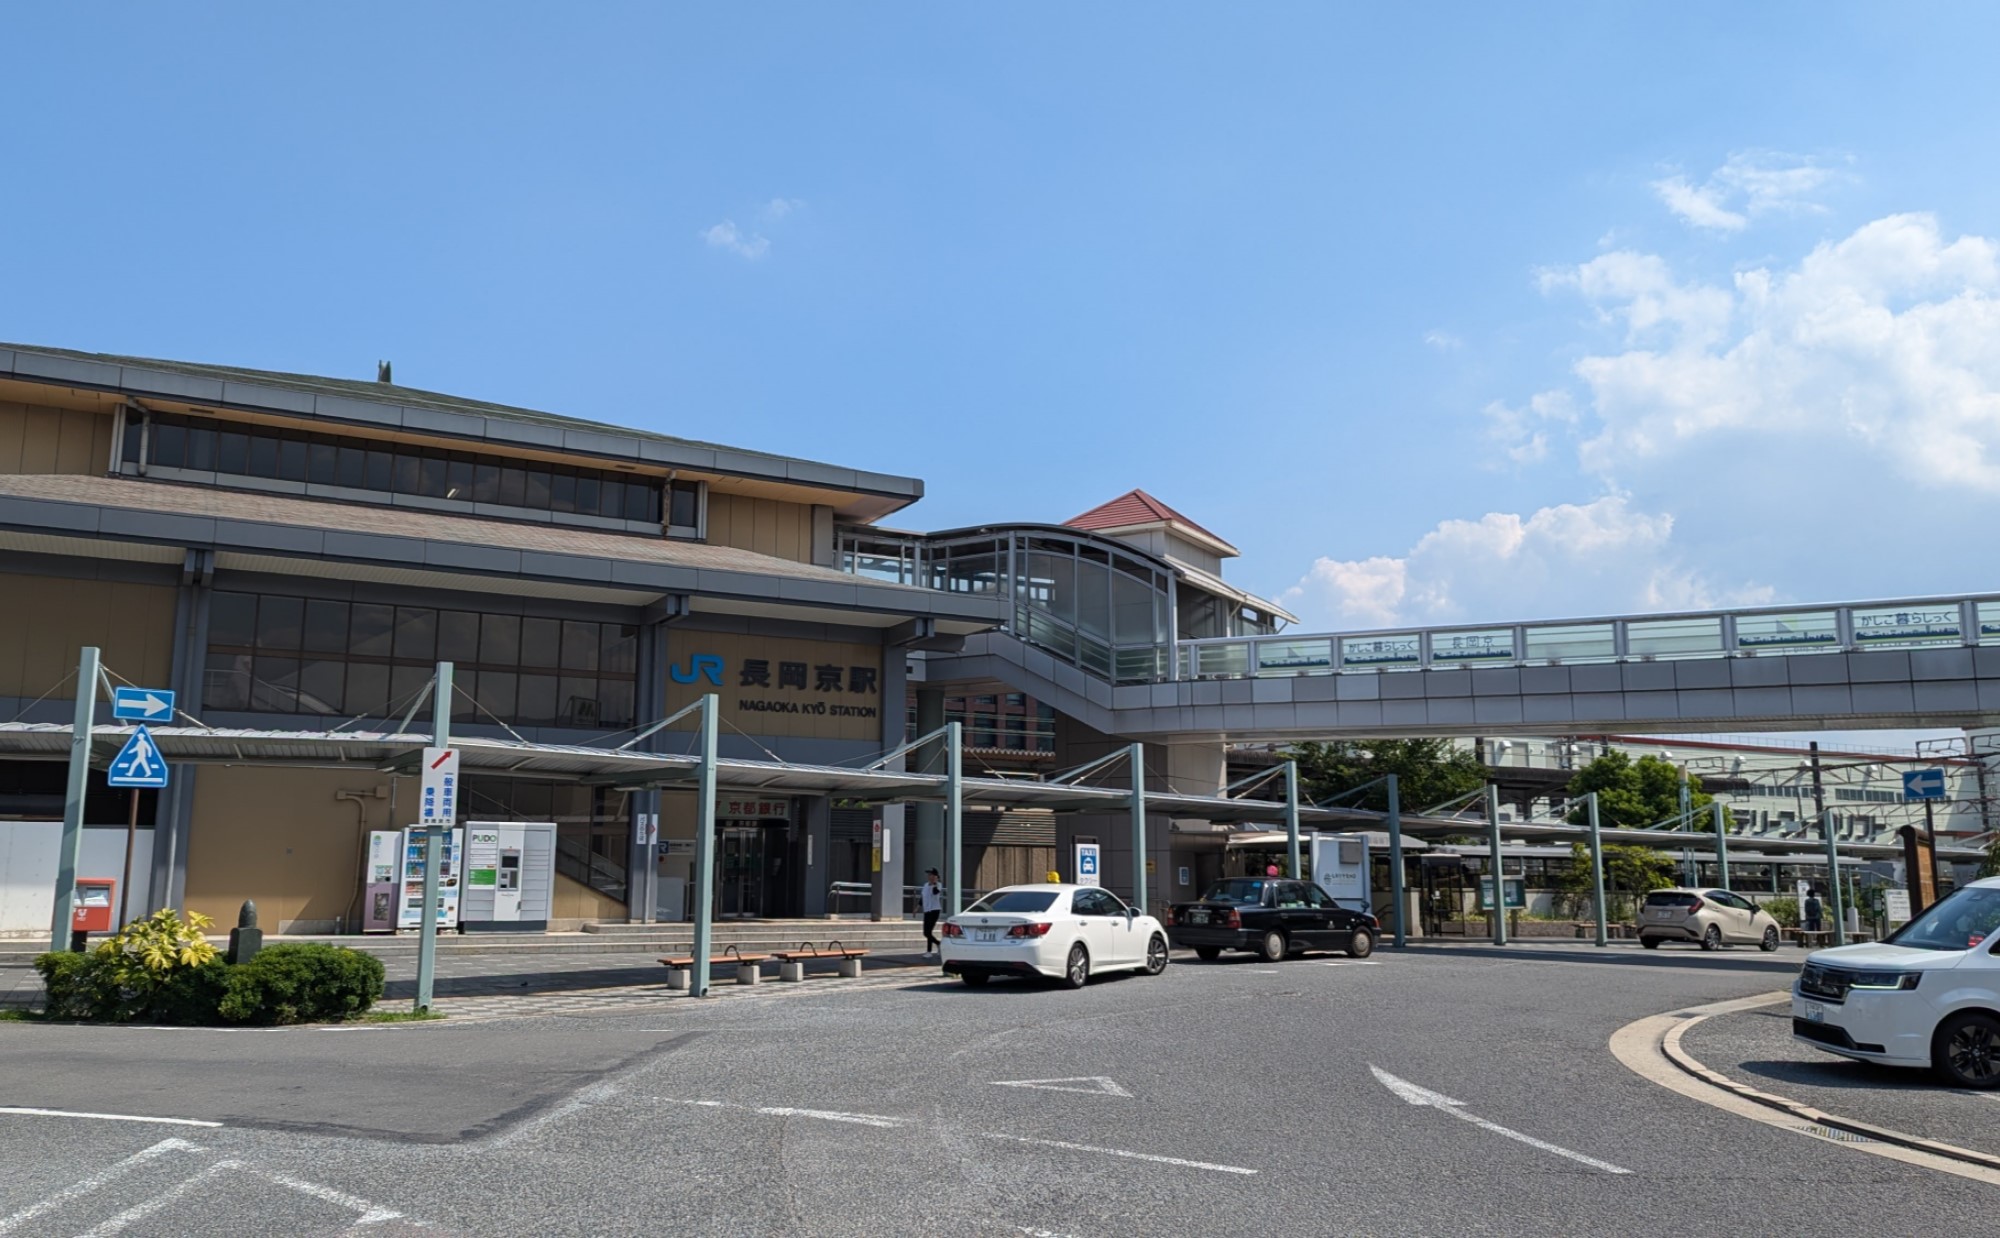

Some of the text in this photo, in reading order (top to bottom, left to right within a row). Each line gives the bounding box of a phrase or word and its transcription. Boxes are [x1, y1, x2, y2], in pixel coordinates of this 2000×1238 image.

[1452, 635, 1495, 649] 長岡京
[671, 653, 724, 687] JR
[739, 658, 878, 694] 長岡京駅
[739, 700, 799, 714] NAGAOKA
[829, 705, 877, 718] STATION
[728, 801, 786, 816] 京都銀行
[472, 834, 497, 843] PUDO
[1081, 848, 1096, 856] TAXI
